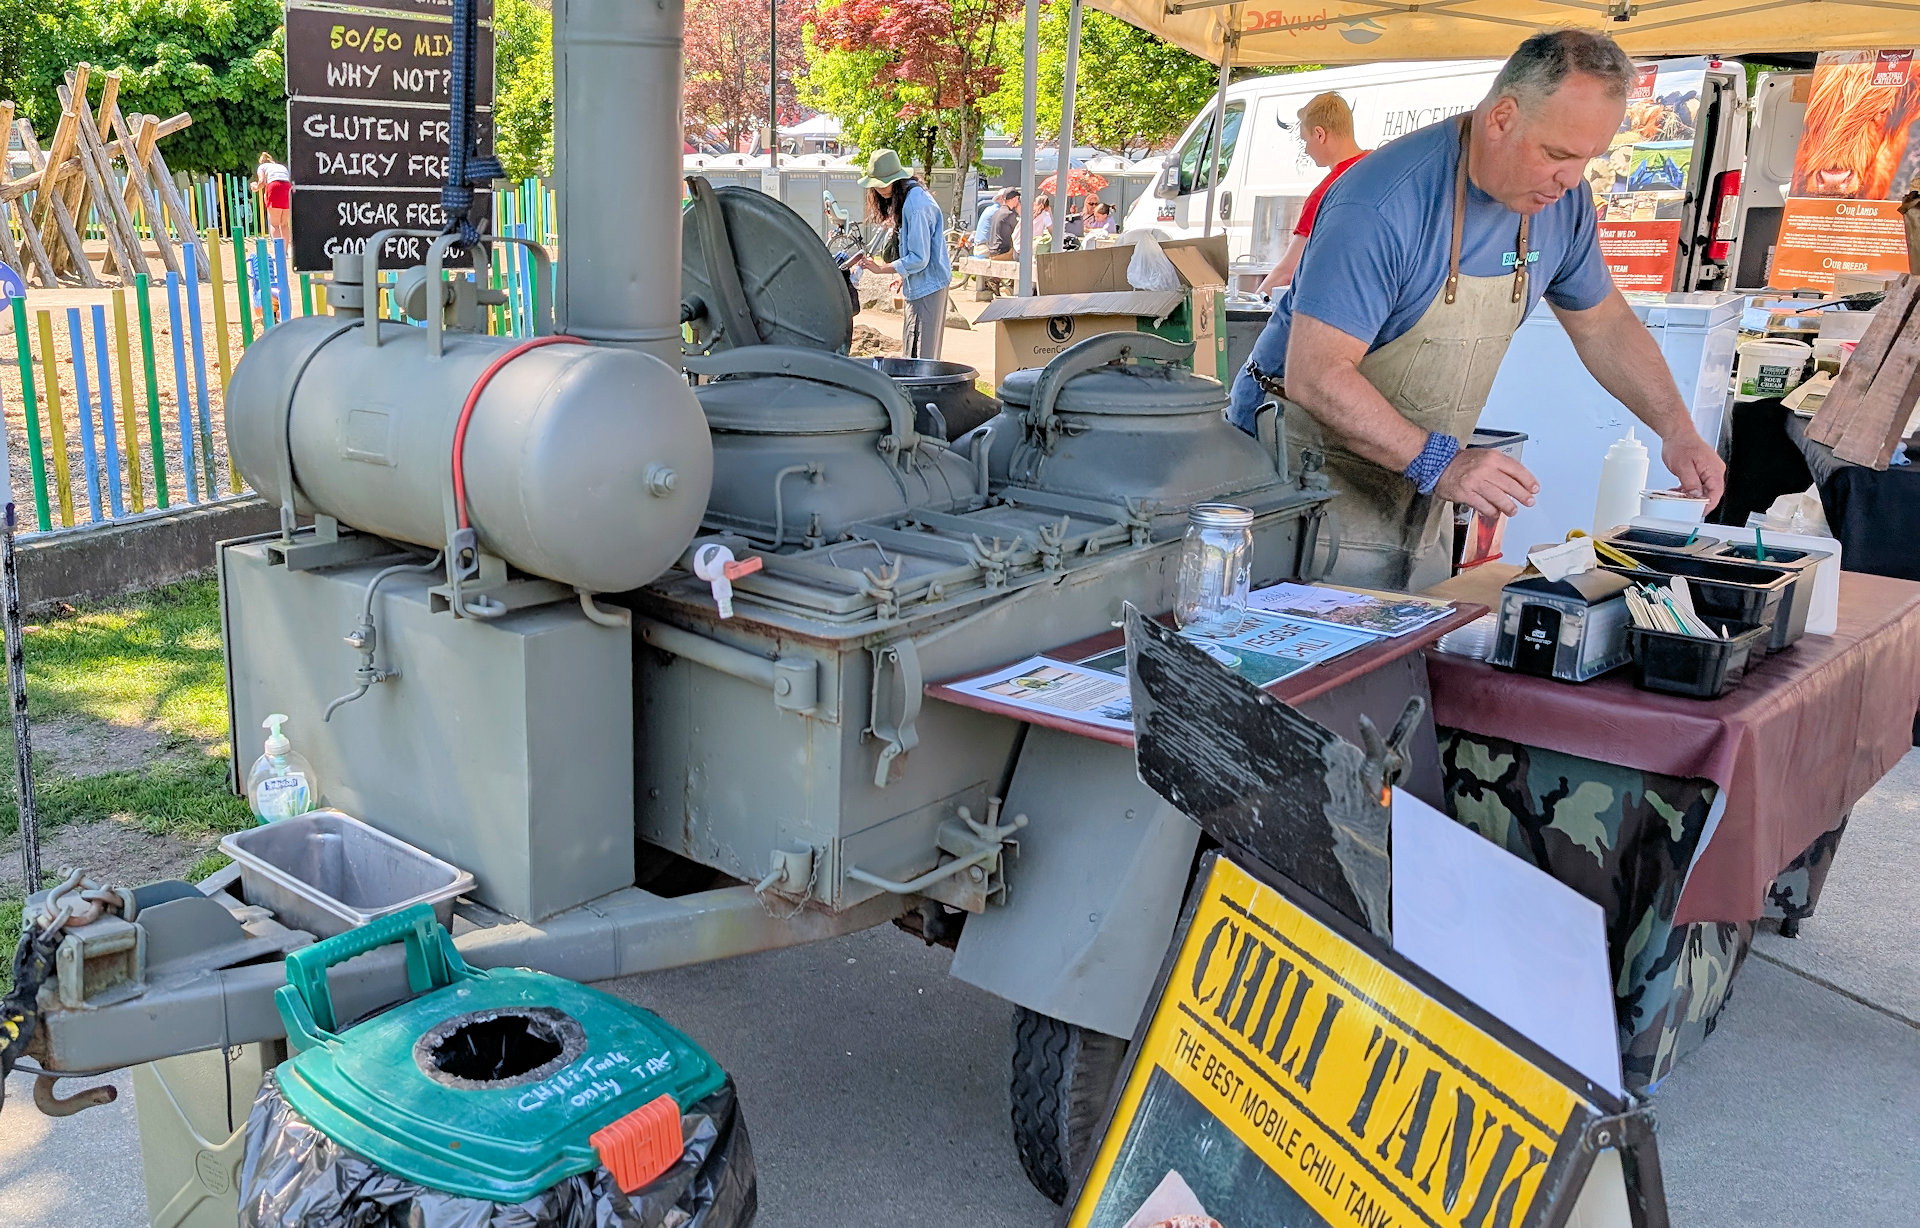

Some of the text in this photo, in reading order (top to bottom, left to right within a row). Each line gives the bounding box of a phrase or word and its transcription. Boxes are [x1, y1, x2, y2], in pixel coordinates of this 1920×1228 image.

[330, 25, 402, 53] 50/50
[327, 61, 452, 95] WHY NOT?
[303, 113, 410, 142] GLUTEN
[315, 151, 450, 179] DAIRY FRE
[337, 201, 400, 227] SUGAR
[1836, 203, 1879, 216] OUR LANDS
[324, 236, 371, 259] GOO
[385, 237, 421, 260] FOR
[1823, 257, 1868, 271] OUR BREEDS
[1276, 638, 1332, 658] CHILI
[1191, 916, 1549, 1228] CHILI TANK
[1174, 1028, 1393, 1228] THE BEST MOBILE CHILI TANK
